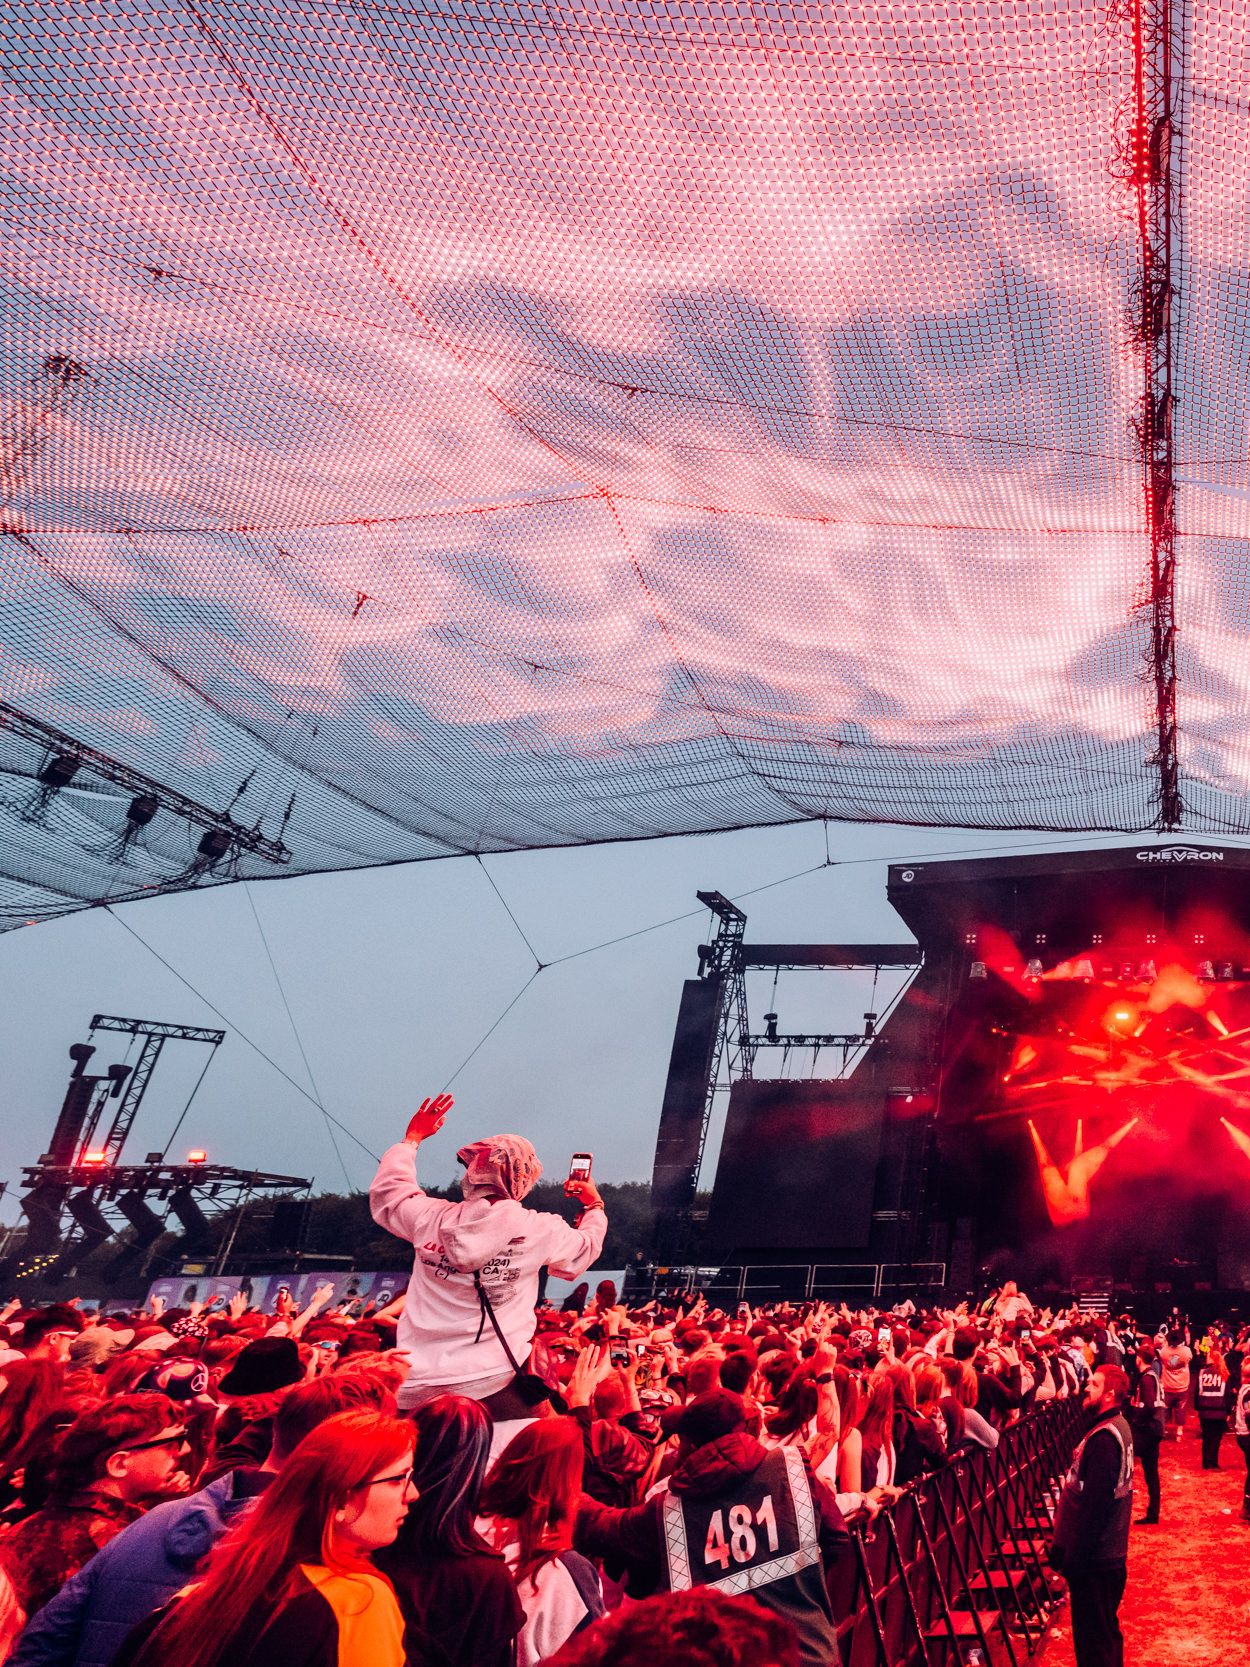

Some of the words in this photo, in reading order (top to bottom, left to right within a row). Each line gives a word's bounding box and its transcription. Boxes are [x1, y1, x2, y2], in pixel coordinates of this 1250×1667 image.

[1136, 850, 1224, 862] CHEVRON
[482, 1266, 500, 1275] CA
[1202, 1373, 1221, 1387] 2241
[704, 1494, 779, 1570] 481
